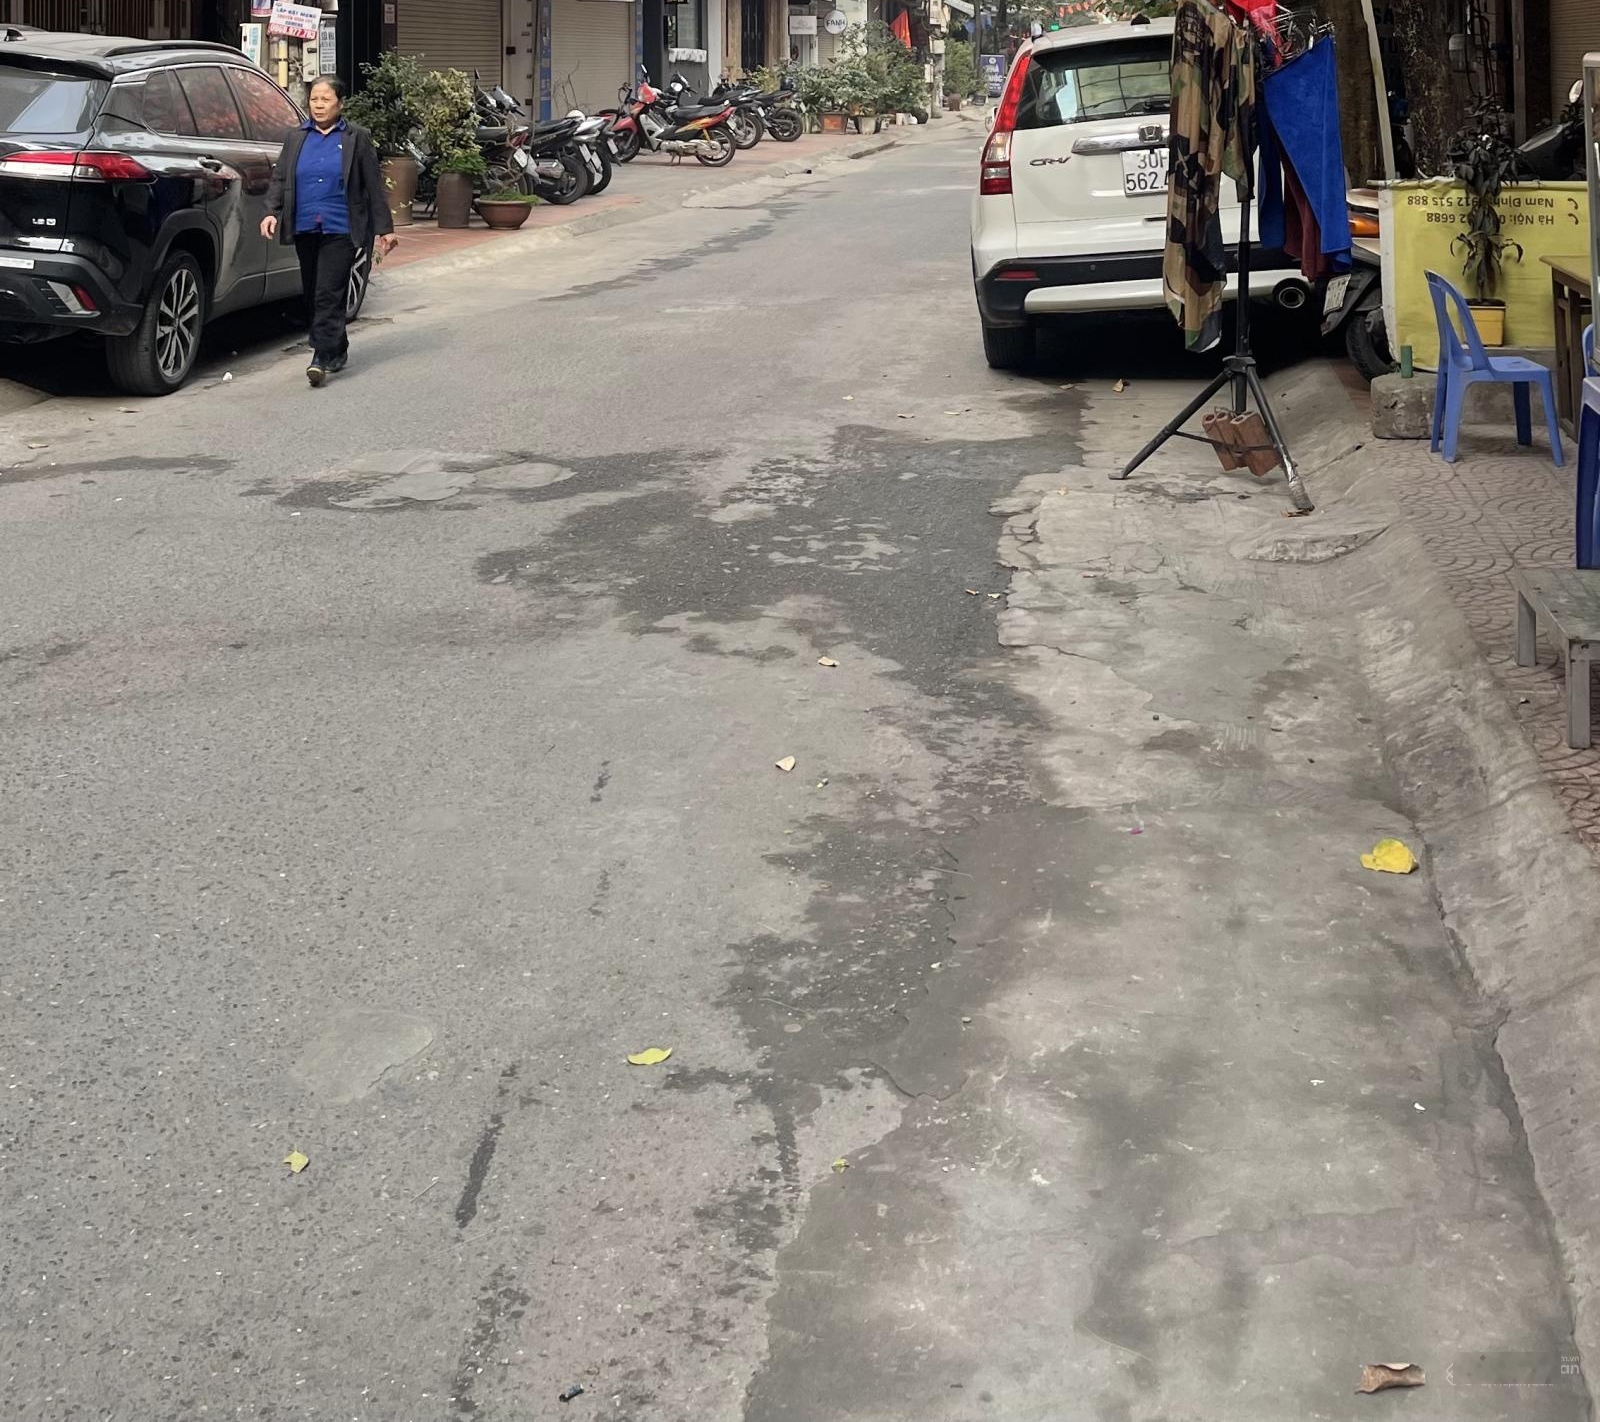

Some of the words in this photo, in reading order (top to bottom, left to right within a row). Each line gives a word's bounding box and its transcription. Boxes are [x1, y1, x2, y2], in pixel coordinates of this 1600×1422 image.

[1407, 195, 1428, 206] 888
[1431, 197, 1452, 207] 515
[1457, 196, 1482, 207] 912
[1525, 197, 1554, 208] Nam
[1426, 212, 1456, 223] 6688
[1509, 213, 1536, 225] Nội:
[1539, 214, 1554, 225] Hà
